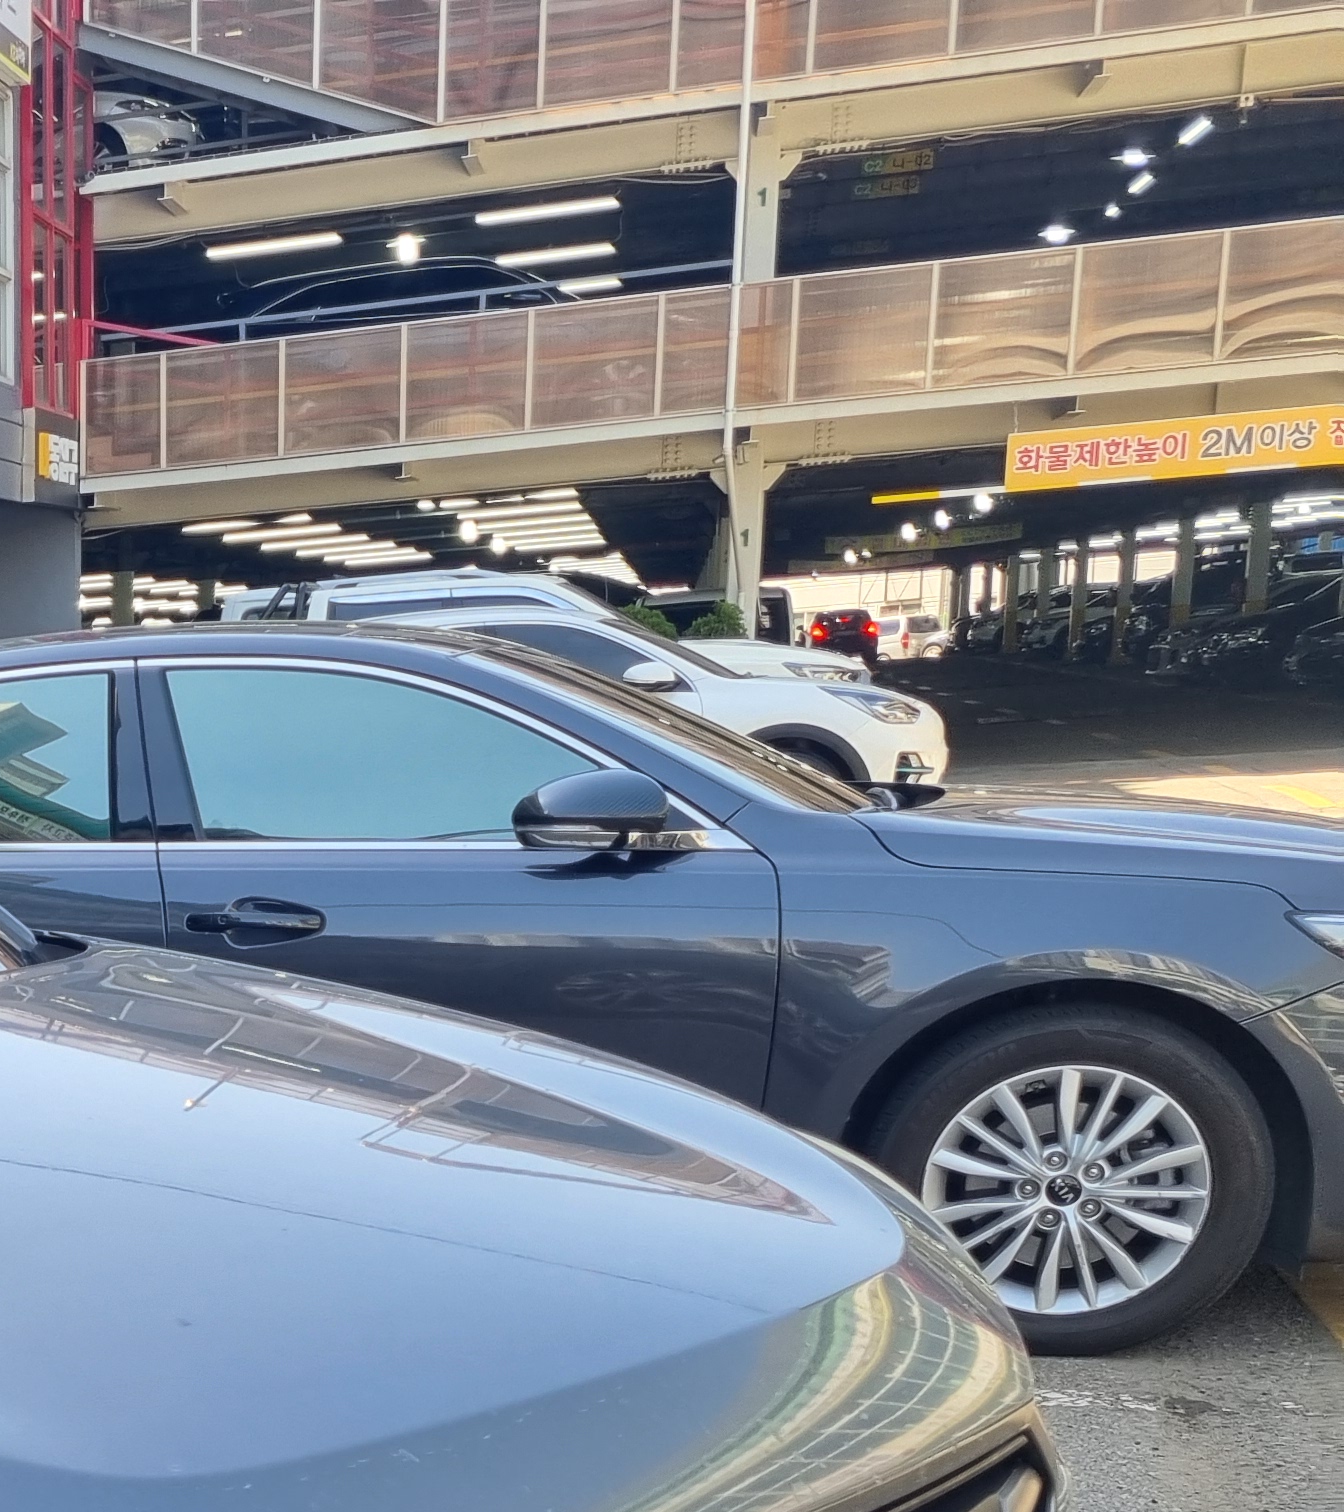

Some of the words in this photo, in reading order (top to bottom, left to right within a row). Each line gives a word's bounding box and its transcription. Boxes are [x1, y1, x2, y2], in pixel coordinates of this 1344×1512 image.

[757, 187, 767, 207] 1
[1013, 431, 1189, 474] 화물제한높이
[740, 528, 749, 547] 1
